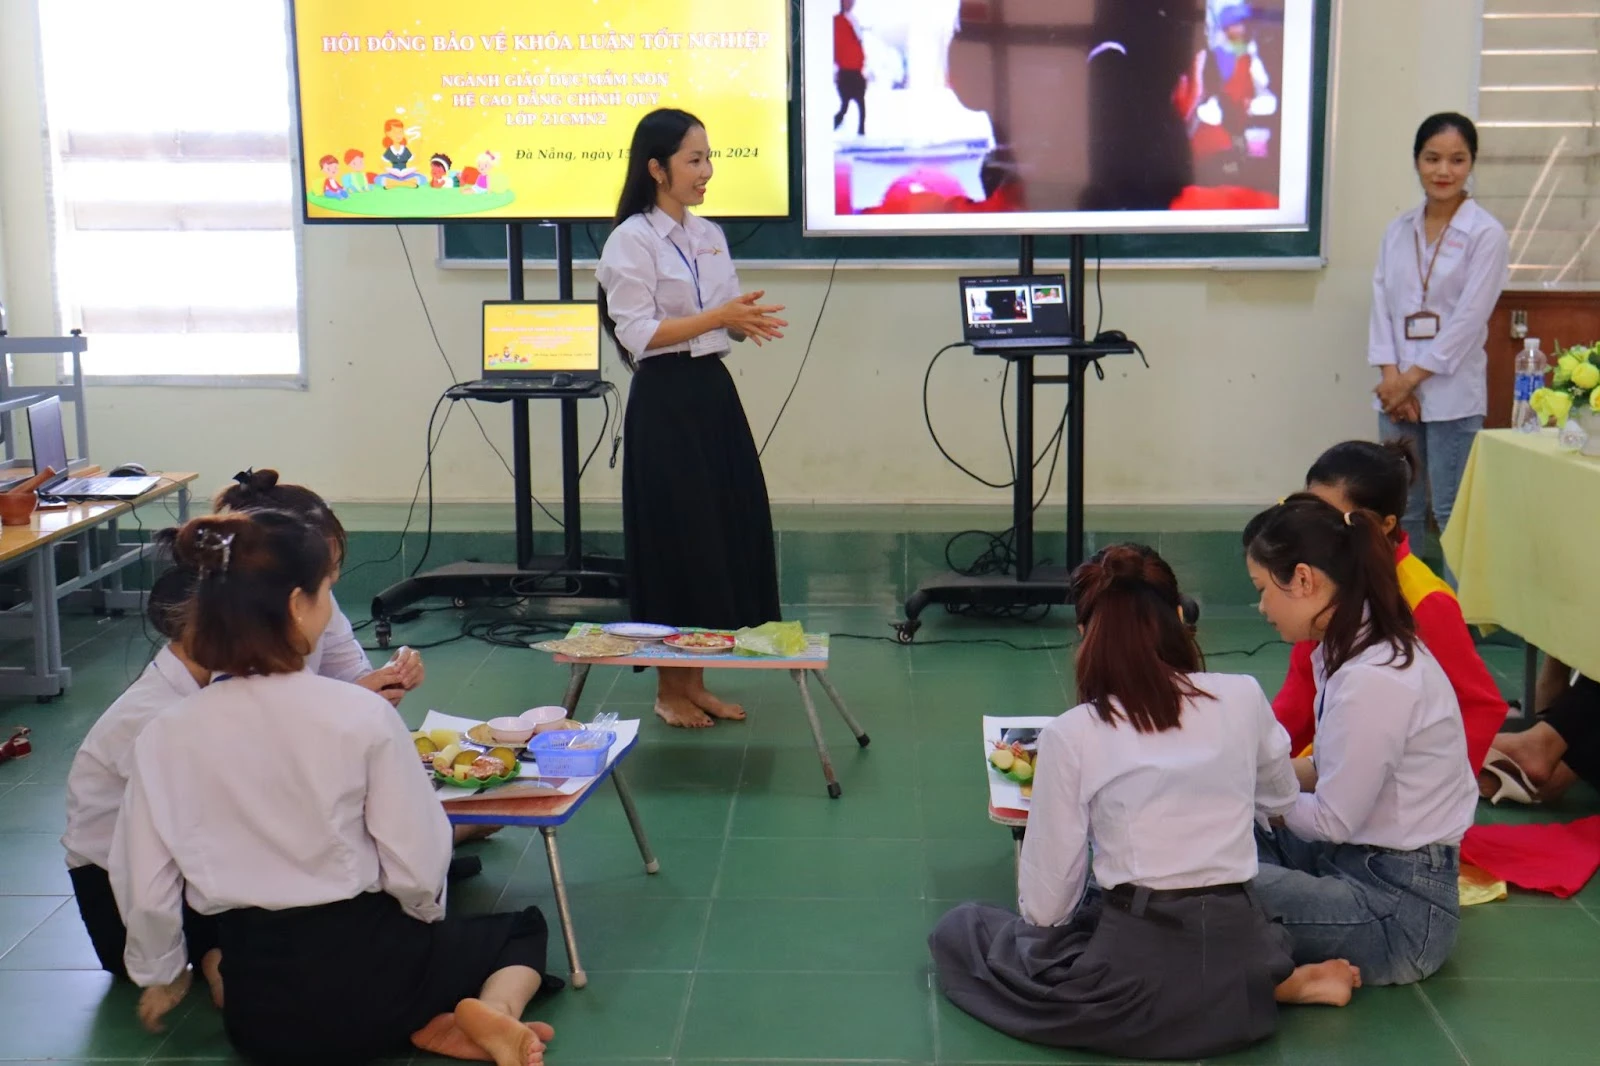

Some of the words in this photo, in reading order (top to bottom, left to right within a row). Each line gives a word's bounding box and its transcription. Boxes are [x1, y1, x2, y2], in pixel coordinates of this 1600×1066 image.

[321, 33, 361, 54] HỘI
[366, 31, 427, 52] ĐỒNG
[432, 31, 475, 52] BẢO
[480, 32, 509, 53] VỆ
[513, 32, 573, 51] KHÓA
[578, 28, 635, 54] LUẬN
[640, 27, 682, 50] TỐT
[688, 28, 770, 51] NGHIỆP
[549, 73, 583, 88] DỤC
[631, 73, 669, 87] NON
[479, 94, 512, 107] CAO
[567, 91, 621, 106] CHÍNH
[625, 92, 660, 107] QUY
[541, 113, 608, 126] 21CMN2
[516, 149, 533, 160] Đà
[581, 150, 614, 163] ngày
[727, 148, 759, 158] 2024
